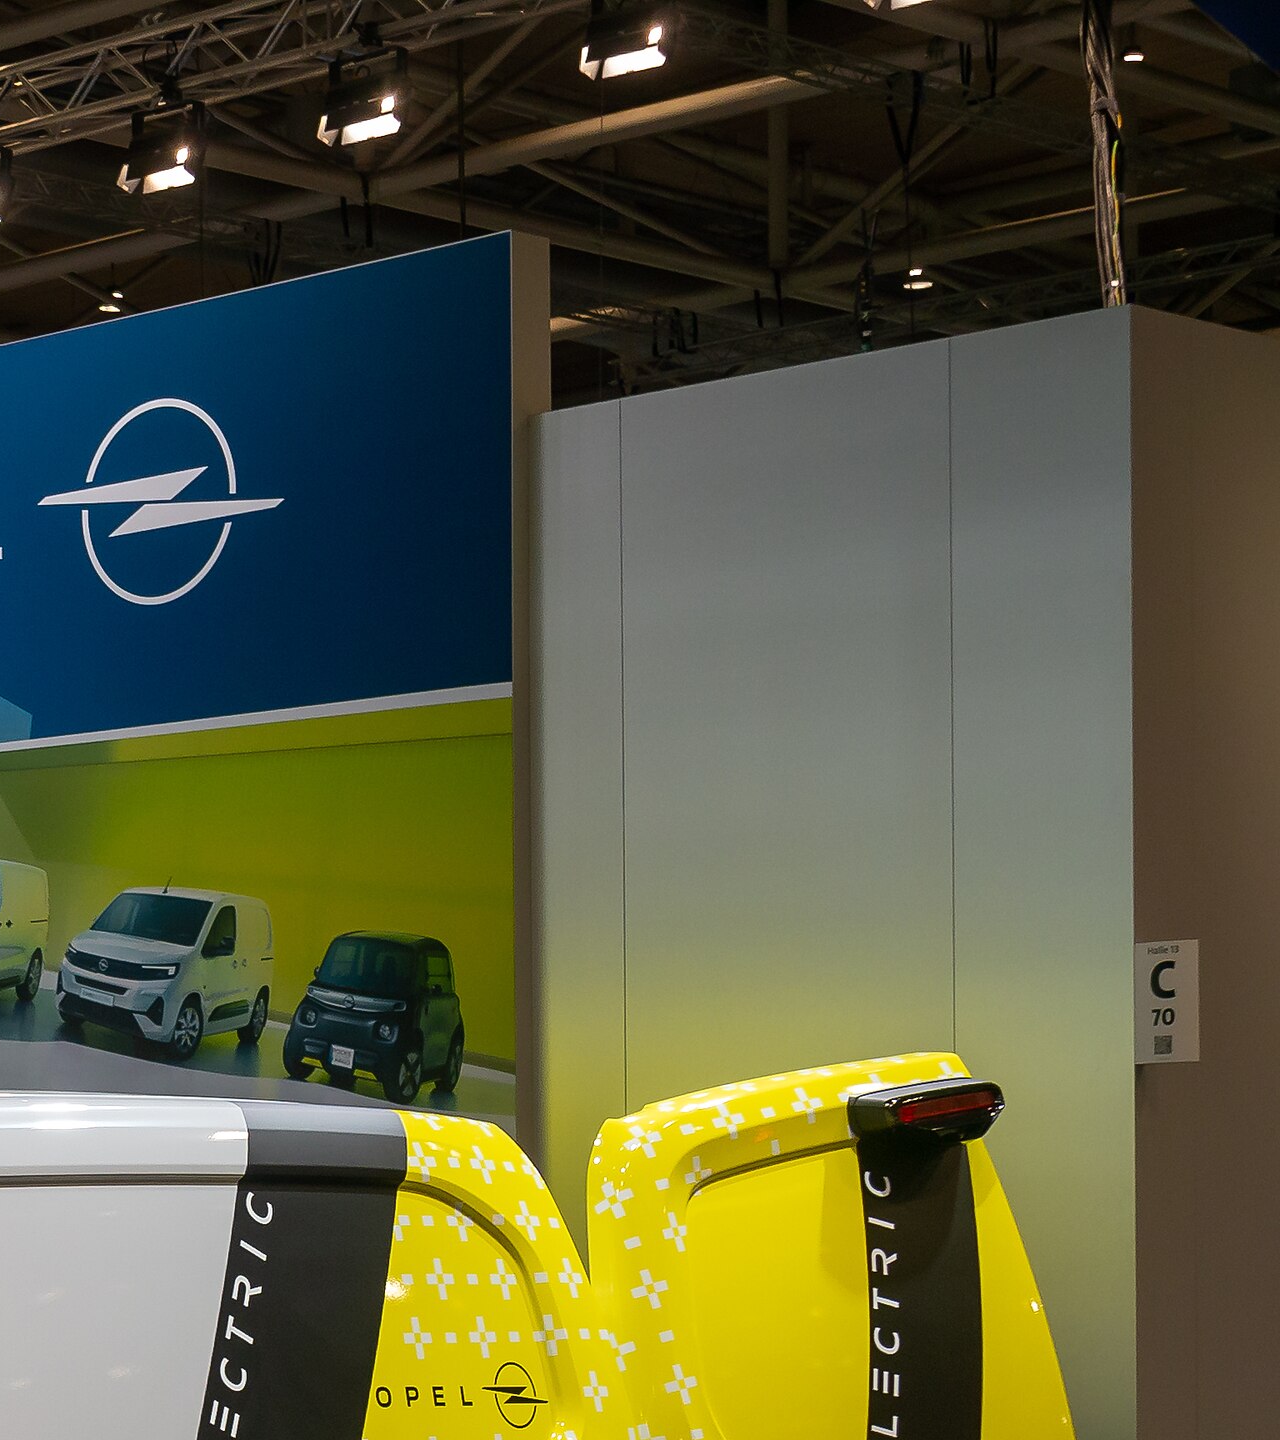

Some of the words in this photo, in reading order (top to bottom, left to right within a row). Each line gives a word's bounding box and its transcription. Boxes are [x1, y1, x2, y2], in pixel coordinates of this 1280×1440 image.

[1150, 960, 1176, 999] C
[1151, 1008, 1176, 1027] 70
[375, 1385, 474, 1409] OPEL
